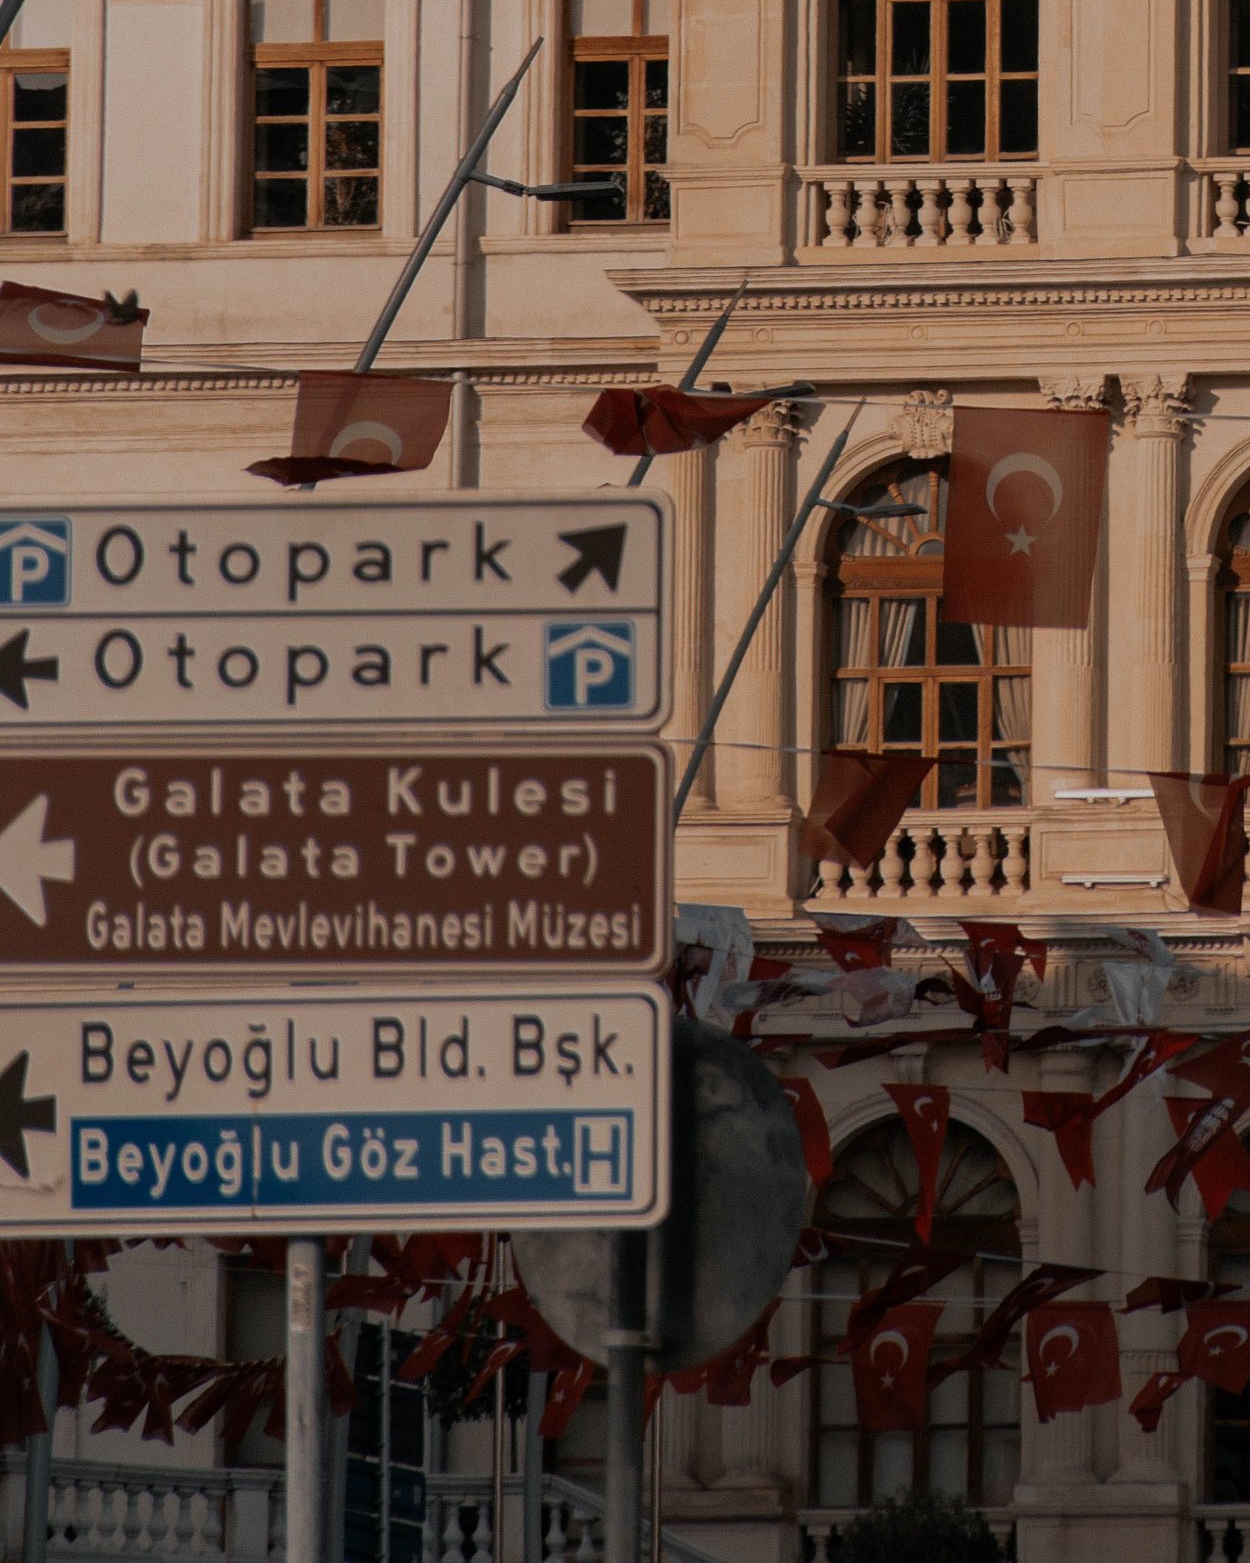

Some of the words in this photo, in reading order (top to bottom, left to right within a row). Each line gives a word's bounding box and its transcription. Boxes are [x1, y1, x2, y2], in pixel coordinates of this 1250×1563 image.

[96, 521, 511, 603] Otopark
[95, 625, 511, 705] Otopark
[574, 646, 615, 705] P
[114, 768, 352, 816] Galata
[387, 767, 617, 815] Kulesi
[130, 834, 360, 887] (Galata
[387, 833, 597, 885] Tower)
[86, 901, 205, 950] Galata
[220, 901, 493, 950] Mevlevihanesi
[507, 900, 641, 949] Müzesi
[81, 1019, 339, 1101] Beyoğlu
[372, 1016, 486, 1079] Bld.
[512, 1014, 634, 1086] Bşk.
[79, 1125, 300, 1198] Beyoğlu
[322, 1123, 420, 1180] Göz
[441, 1122, 572, 1179] Hast.
